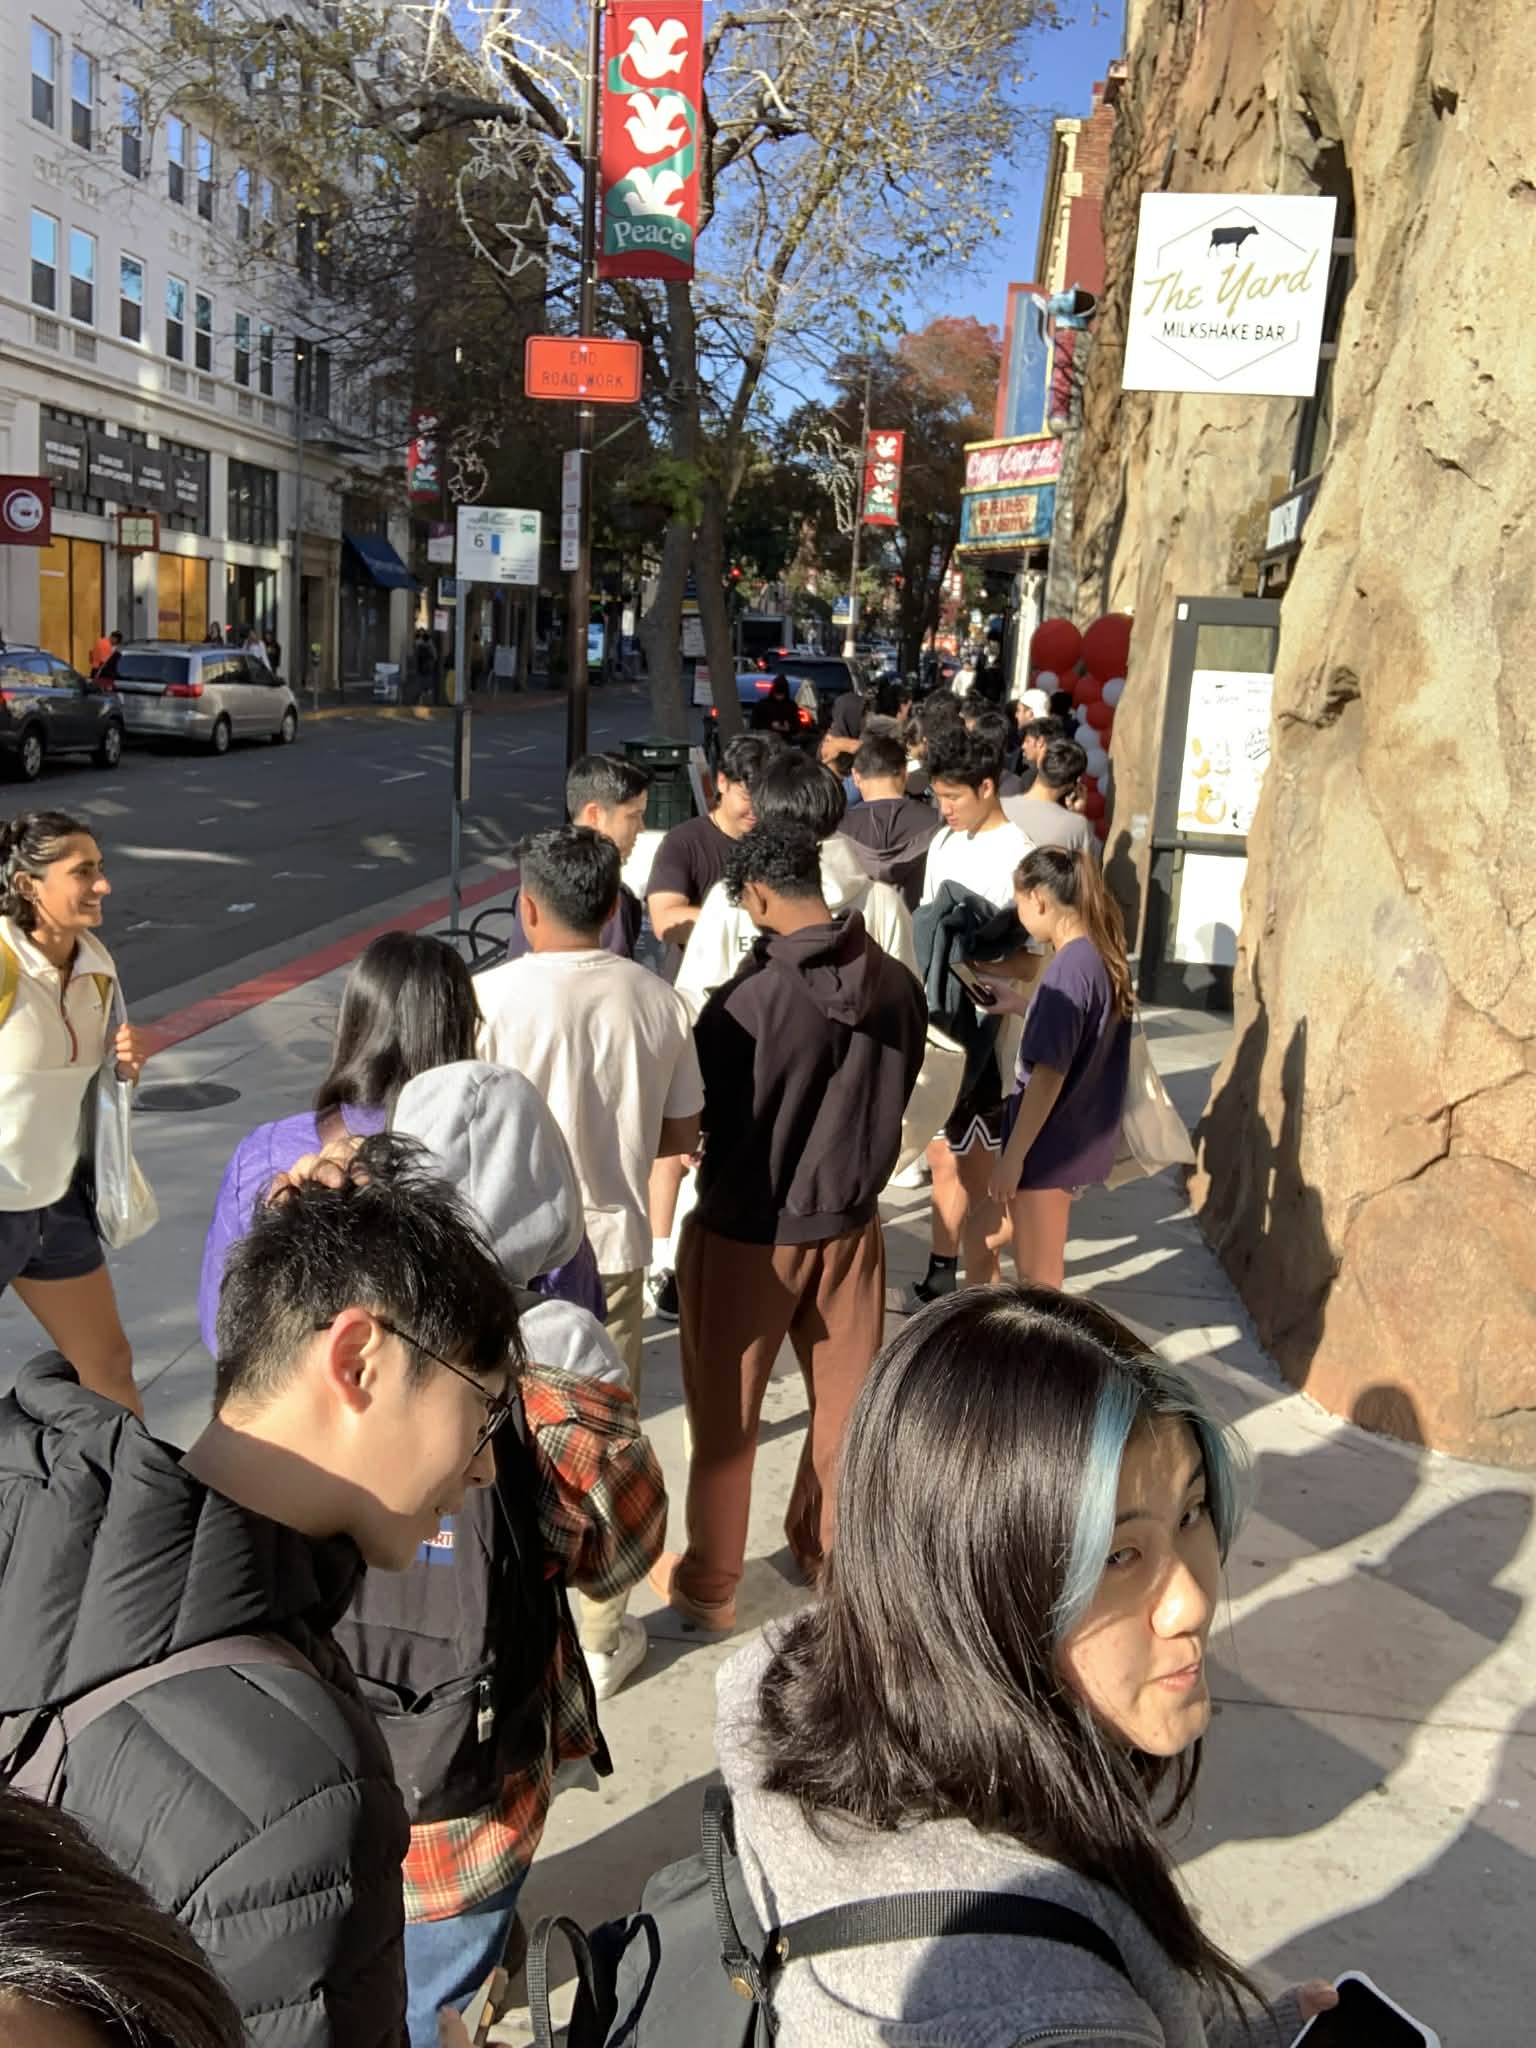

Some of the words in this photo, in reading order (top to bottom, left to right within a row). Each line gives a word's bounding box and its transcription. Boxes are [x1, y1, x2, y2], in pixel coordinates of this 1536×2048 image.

[614, 221, 687, 250] Peace
[1144, 269, 1204, 316] The
[1217, 248, 1320, 318] Yard
[1162, 321, 1249, 341] MILKSHAKE
[1254, 324, 1286, 342] BAR
[570, 350, 598, 366] END
[542, 371, 578, 386] ROAD
[586, 374, 624, 390] WORK
[474, 533, 484, 548] 6
